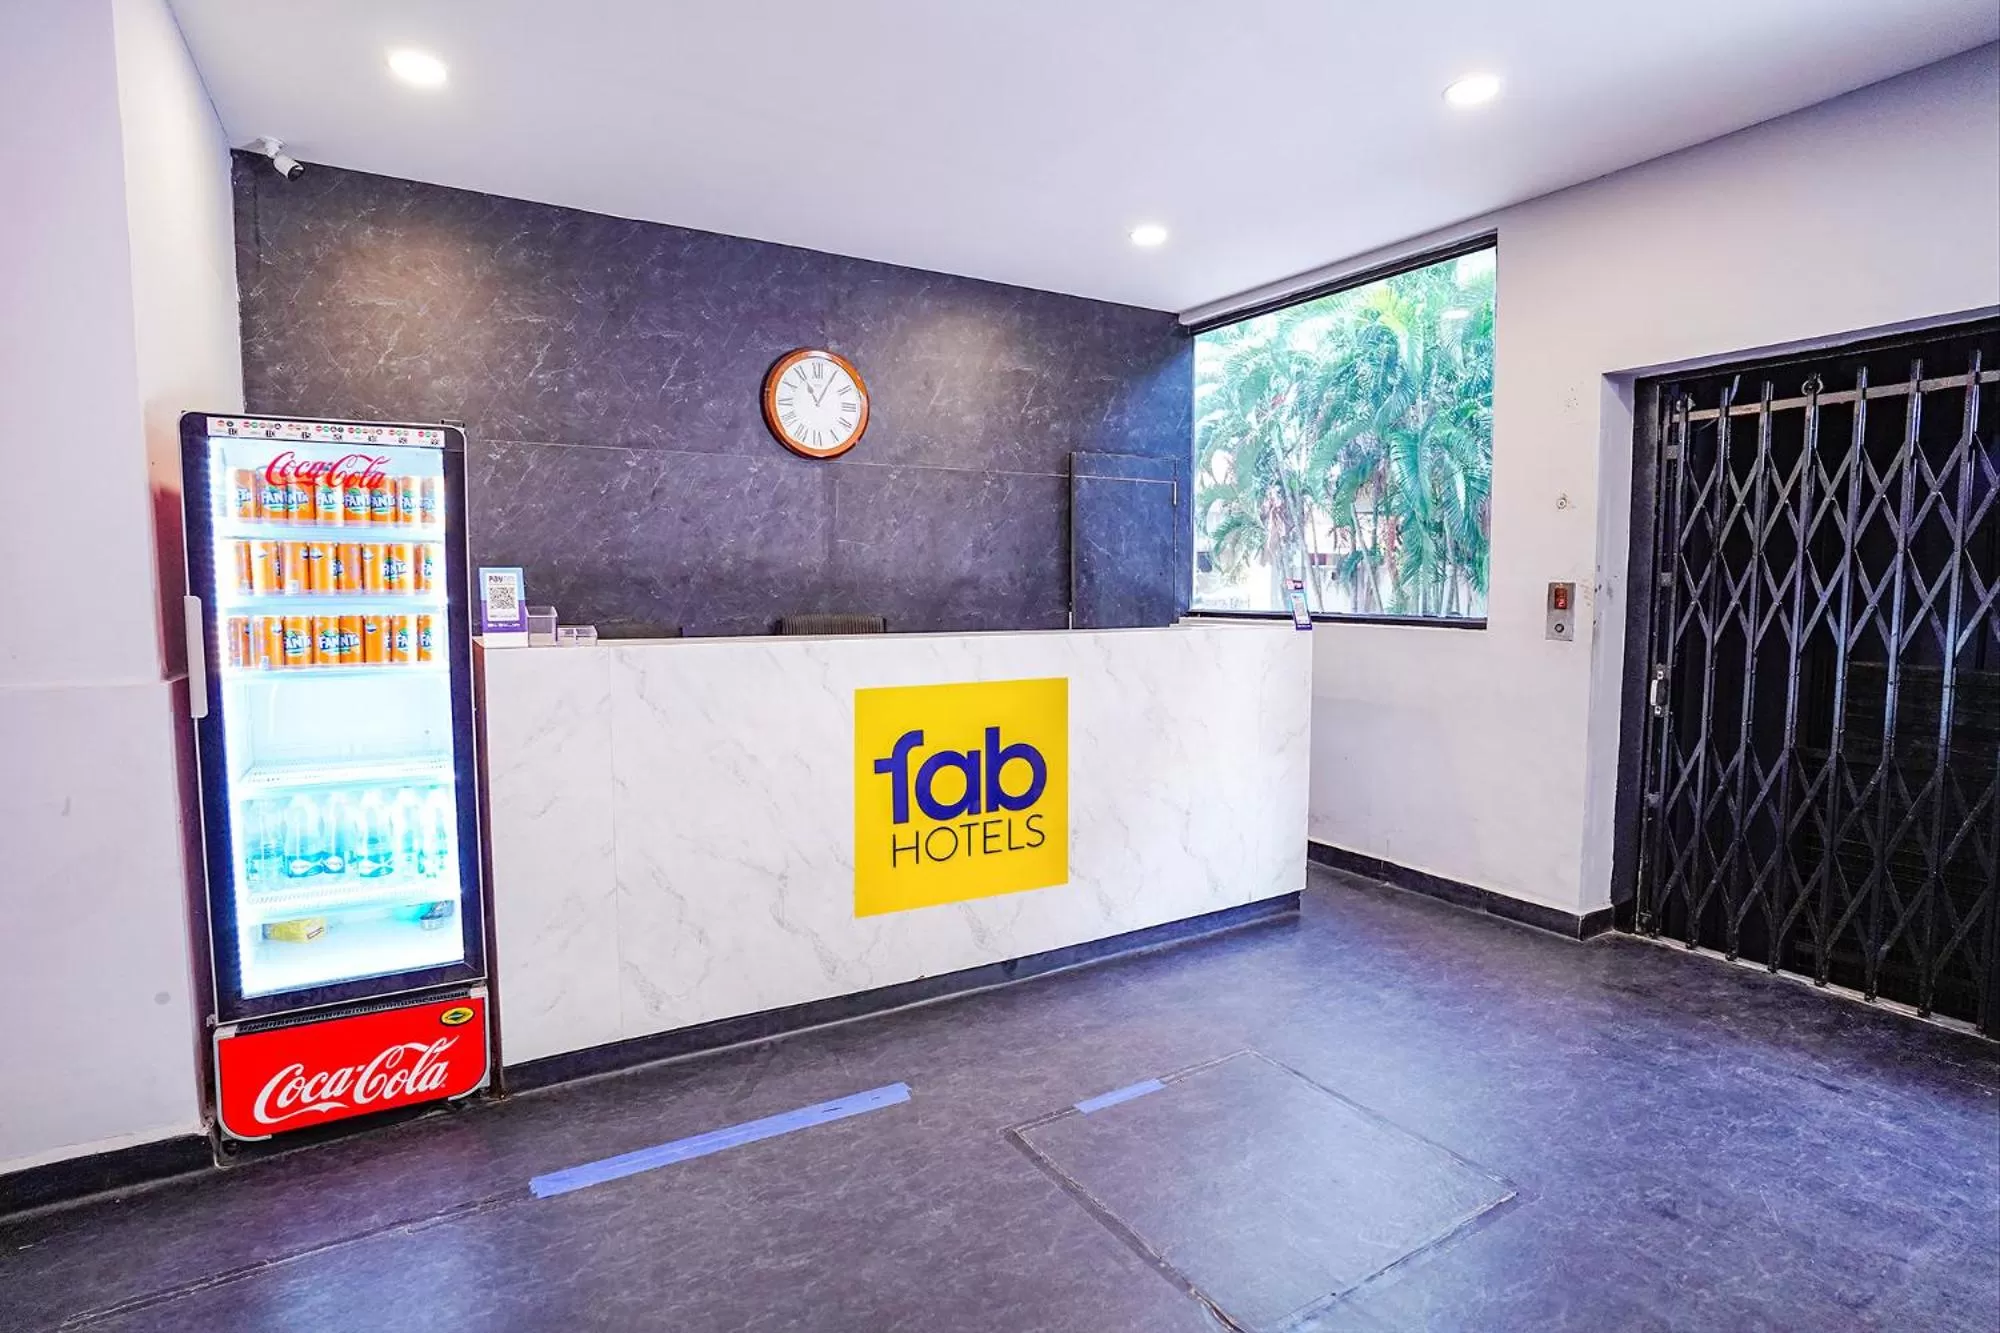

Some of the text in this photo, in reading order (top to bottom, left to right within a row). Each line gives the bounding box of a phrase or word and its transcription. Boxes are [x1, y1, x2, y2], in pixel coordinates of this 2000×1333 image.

[265, 451, 392, 489] Coca-Cola
[874, 726, 1047, 824] fab
[892, 813, 1046, 869] HOTELS
[253, 1035, 460, 1125] Coca-Cola
